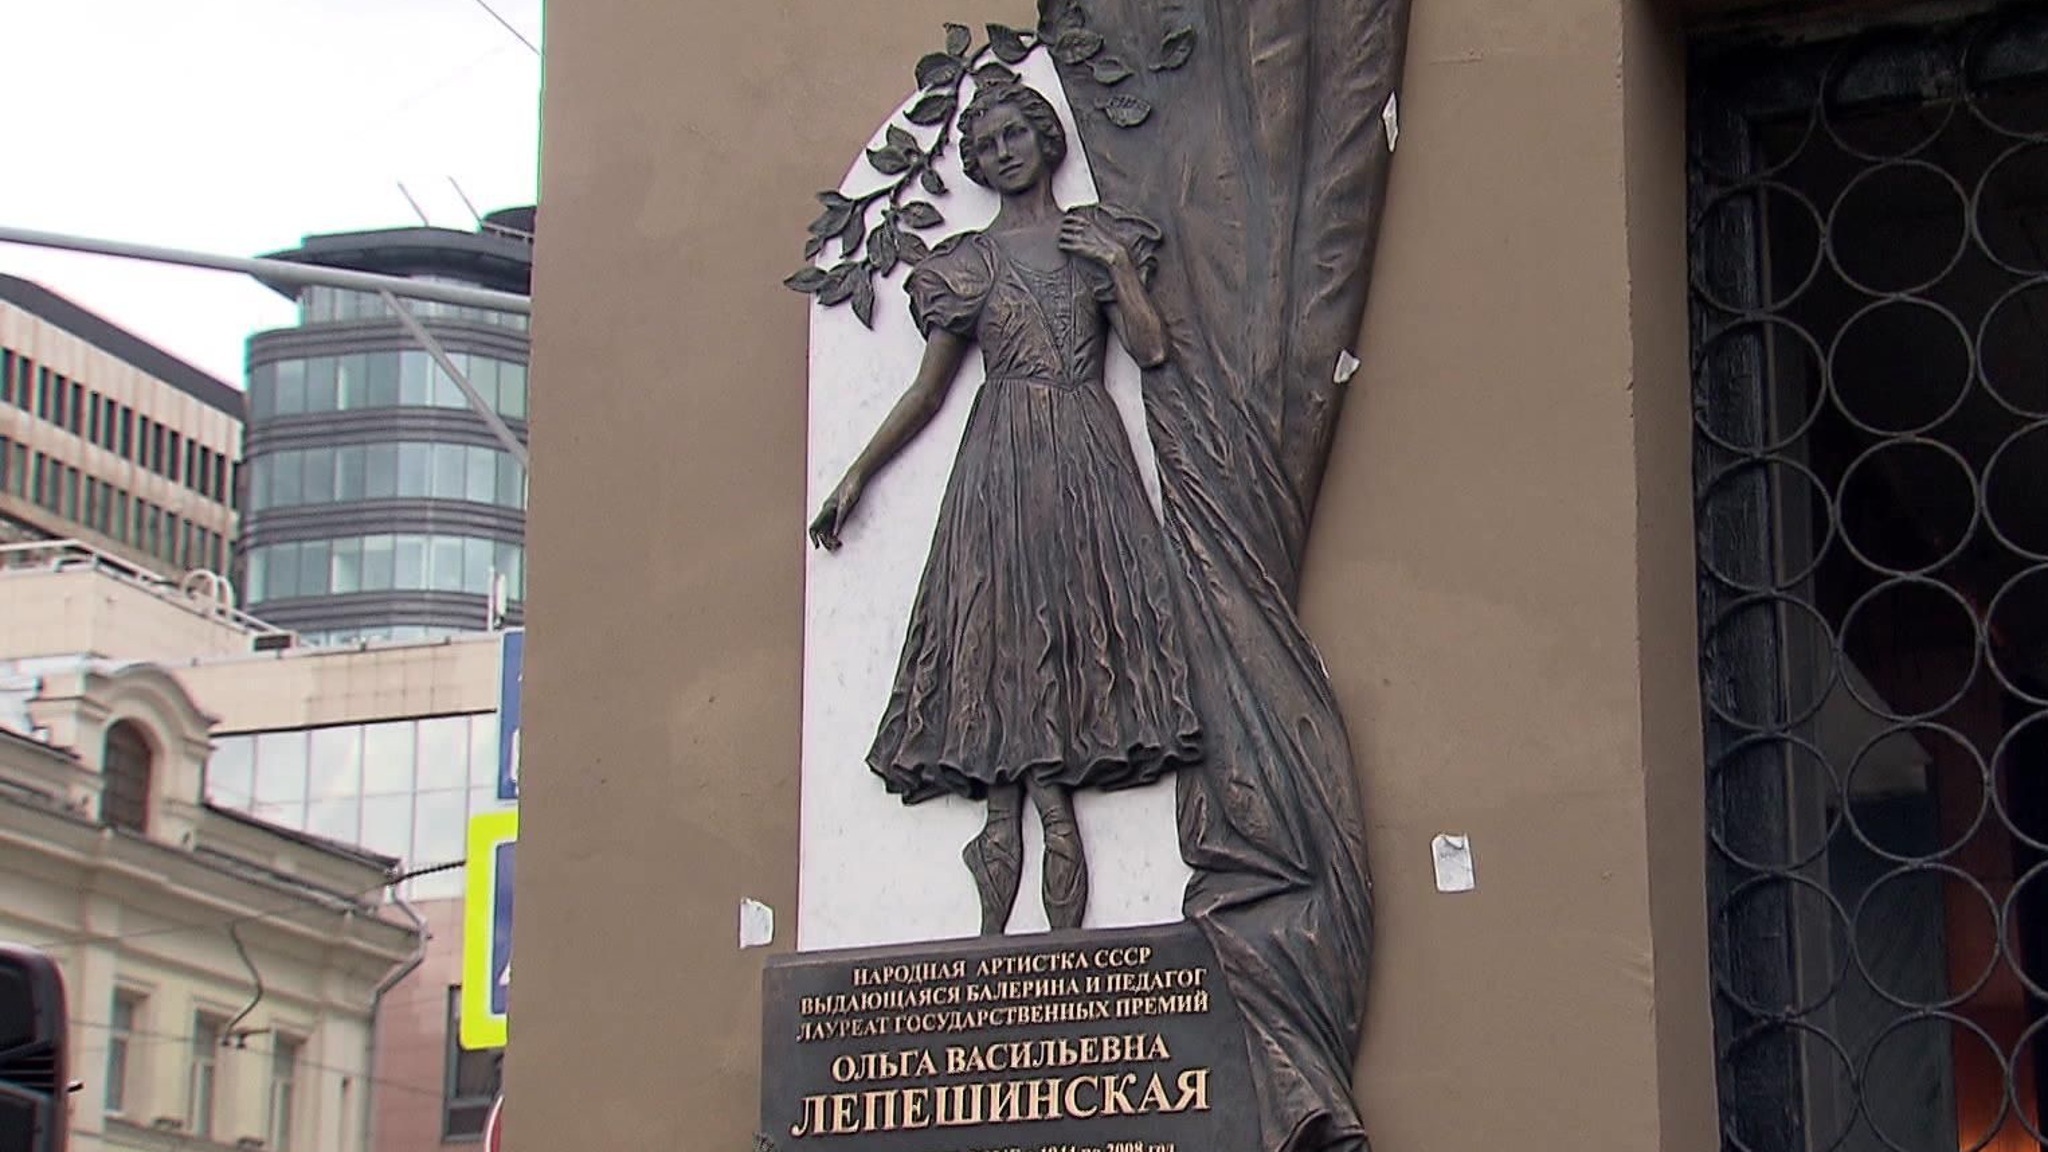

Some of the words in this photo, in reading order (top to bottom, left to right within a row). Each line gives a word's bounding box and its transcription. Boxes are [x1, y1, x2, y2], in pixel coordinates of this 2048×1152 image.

[853, 959, 967, 986] НАРОДНАЯ
[976, 951, 1089, 976] АРТИСТКА
[1094, 946, 1153, 969] СССР
[796, 1016, 890, 1043] ЛАУРЕАТ
[894, 999, 1111, 1034] ГОСУДАРСТВЕННЫХ
[1115, 990, 1210, 1019] ПРЕМИЙ
[800, 985, 961, 1017] ВЫДАЮЩАЯСЯ
[966, 977, 1080, 1003] БАЛЕРИНА
[1086, 975, 1100, 994] И
[1106, 968, 1208, 993] ПЕДАГОГ
[832, 1048, 938, 1082] ОЛЬГА
[946, 1033, 1171, 1075] ВАСИЛЬЕВНА
[791, 1067, 1212, 1137] ЛЕПЕШИНСКАЯ
